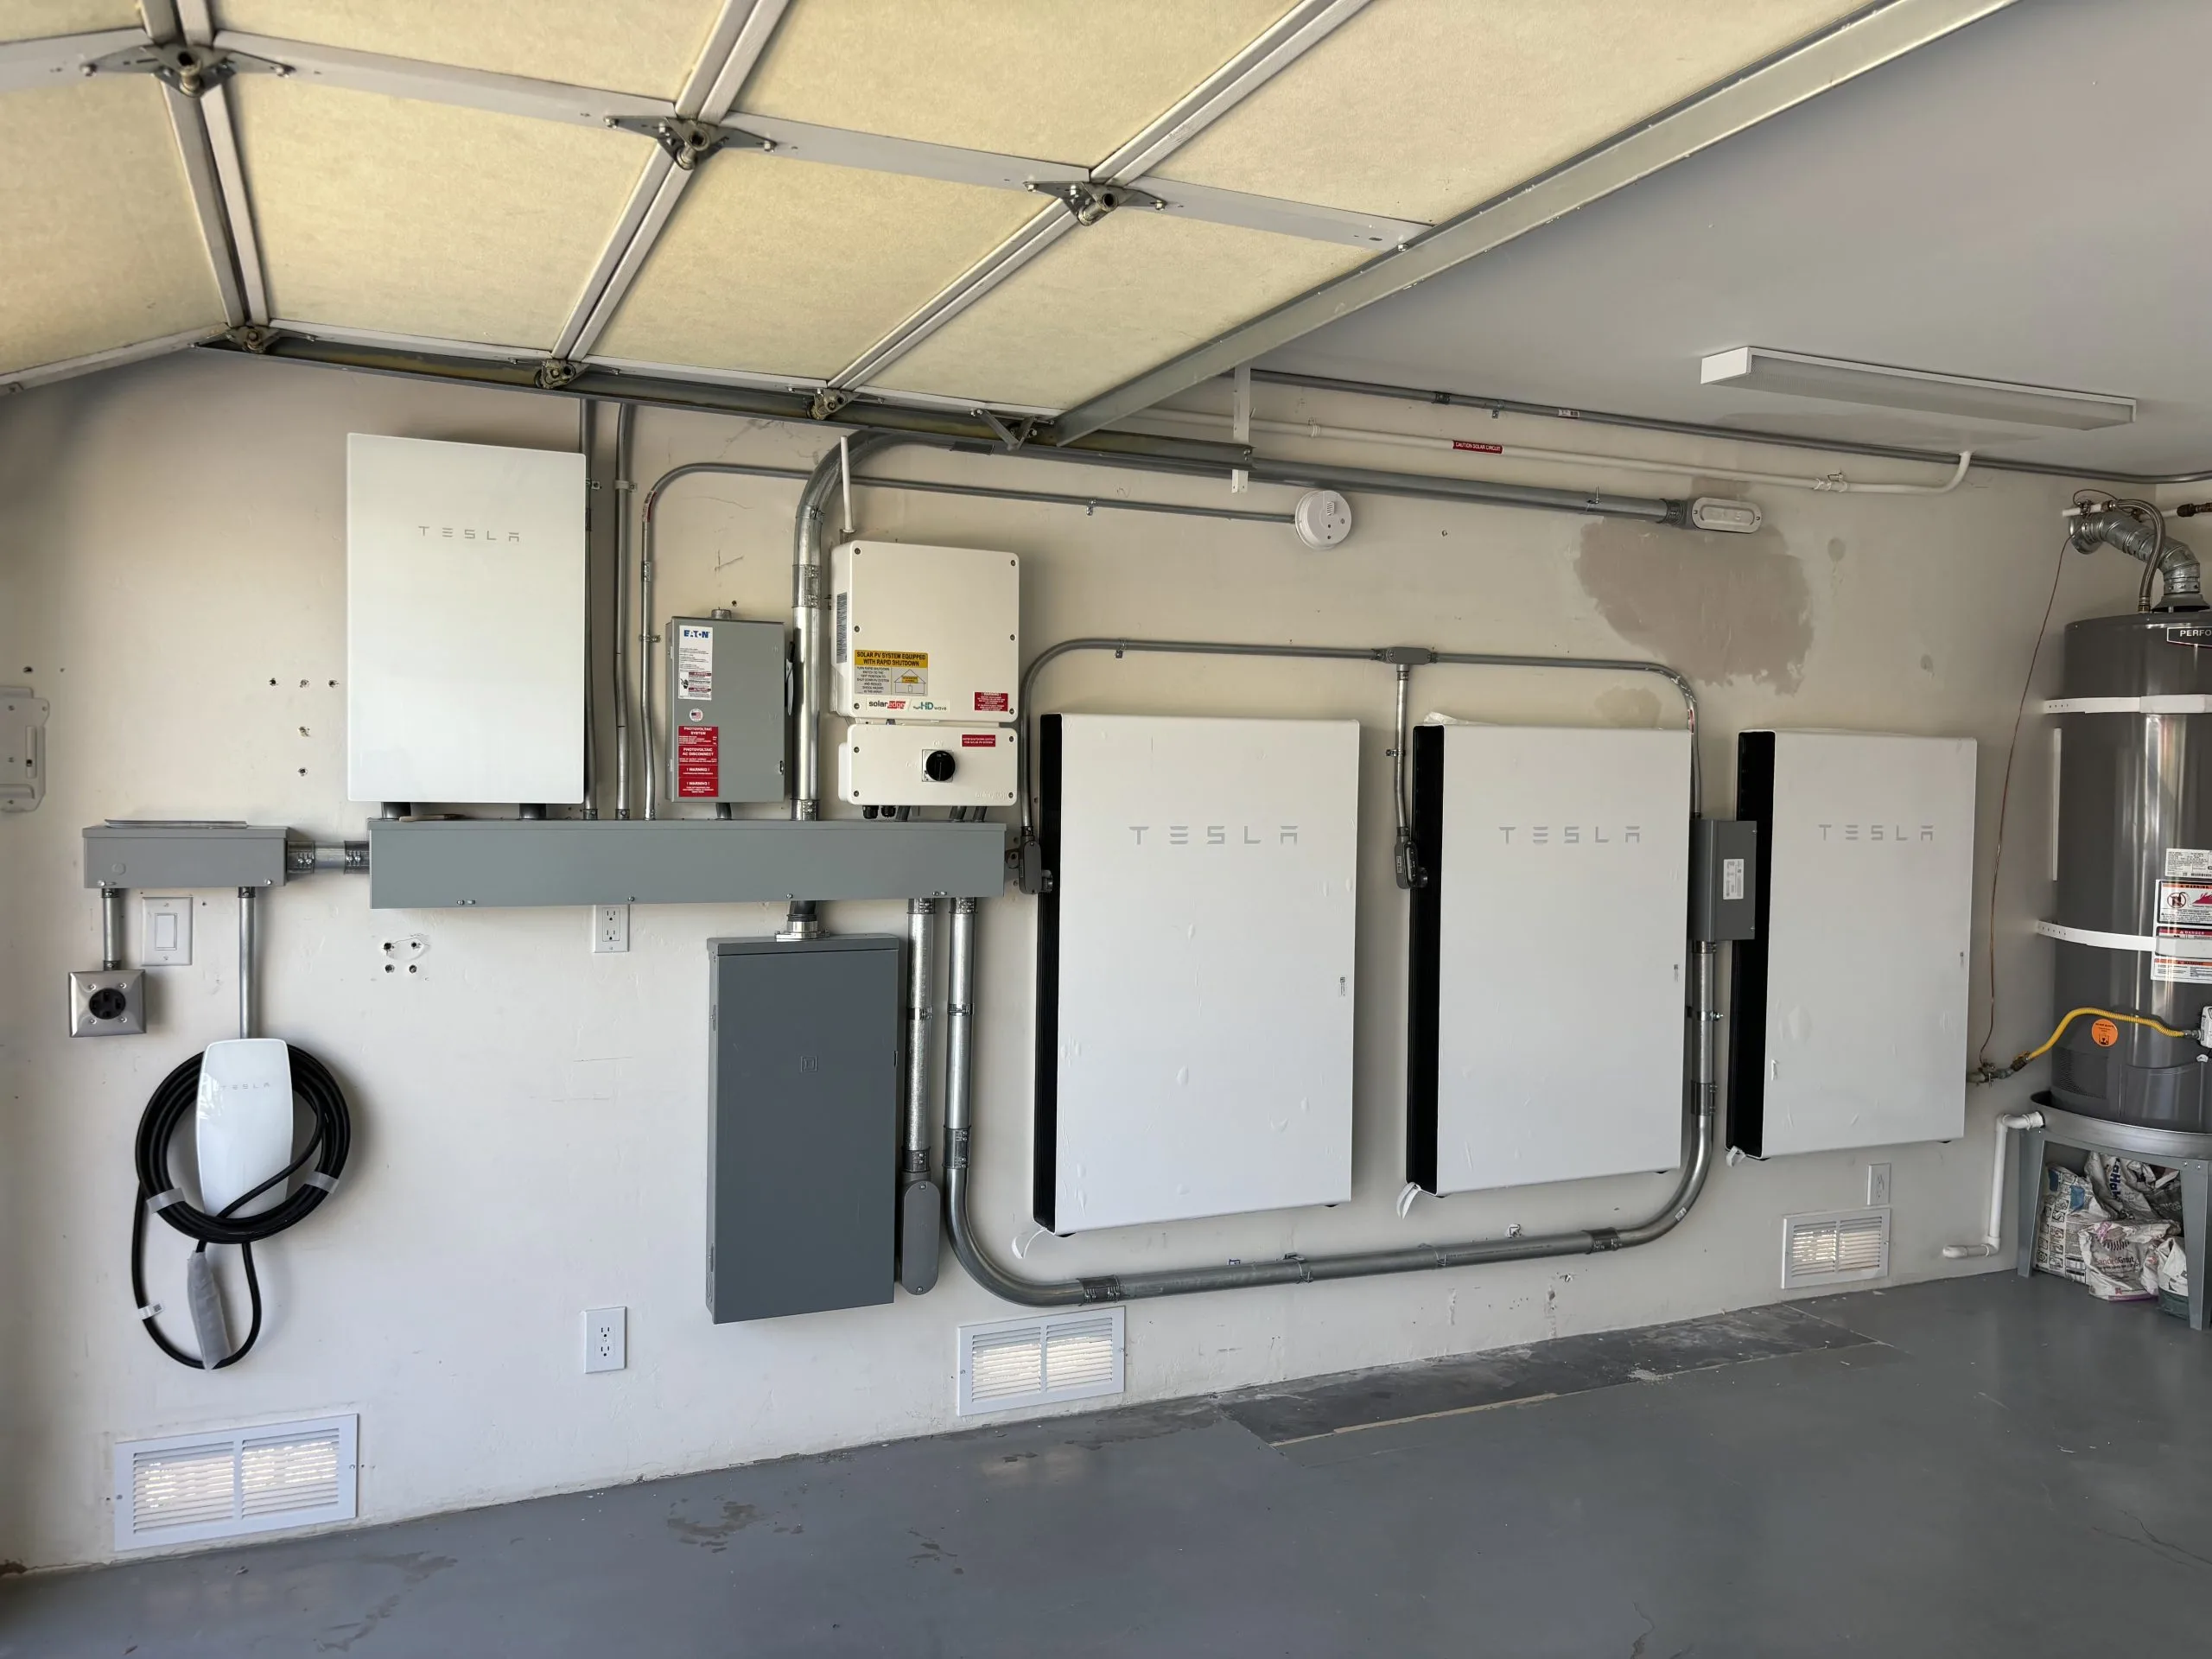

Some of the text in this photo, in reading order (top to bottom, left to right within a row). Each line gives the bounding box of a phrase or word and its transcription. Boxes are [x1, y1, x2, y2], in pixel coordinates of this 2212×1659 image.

[417, 525, 519, 543] TESLA
[683, 630, 709, 639] EATON
[920, 702, 934, 710] HD
[1128, 825, 1299, 845] TESLA
[1498, 826, 1641, 844] TESLA
[1818, 824, 1934, 841] TESLA
